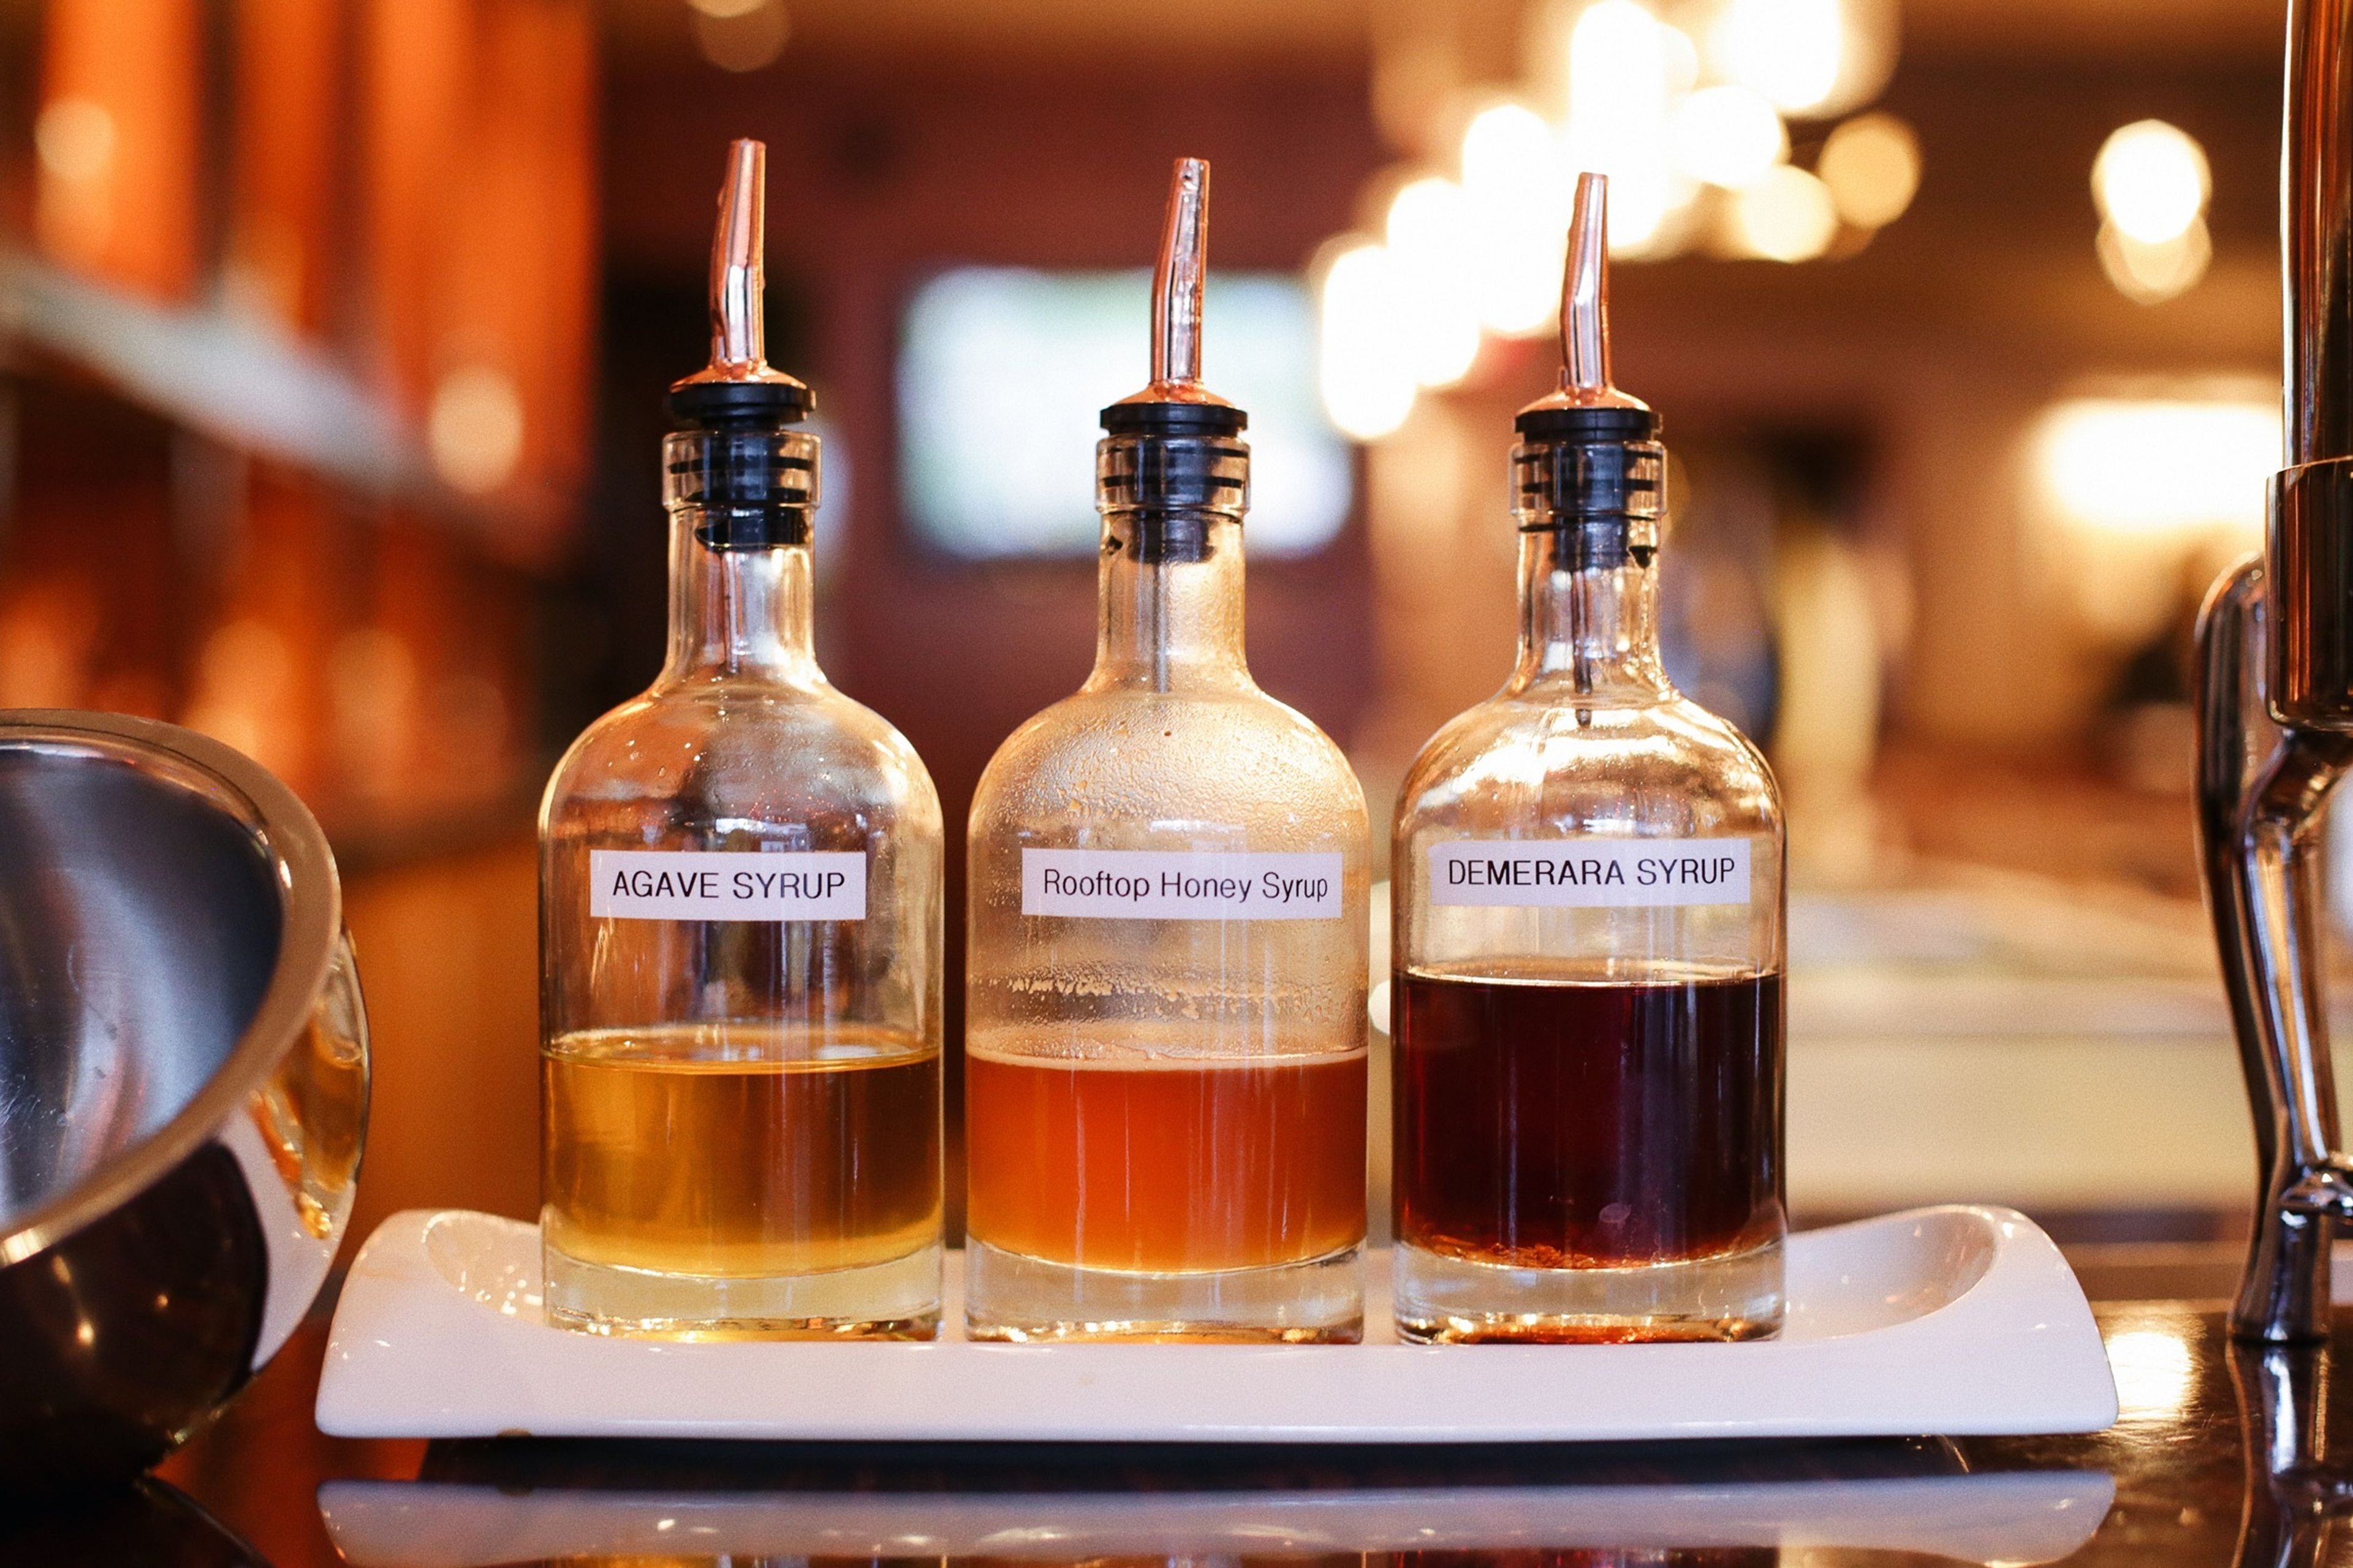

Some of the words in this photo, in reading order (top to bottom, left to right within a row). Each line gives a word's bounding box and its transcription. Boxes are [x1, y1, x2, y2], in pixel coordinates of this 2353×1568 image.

[612, 870, 719, 898] AGAVE
[733, 872, 845, 900] SYRUP
[1044, 868, 1150, 902] Rooftop
[1161, 872, 1252, 903] Honey
[1262, 871, 1328, 903] Syrup
[1449, 859, 1625, 885] DEMERARA
[1637, 857, 1735, 885] SYRUP
